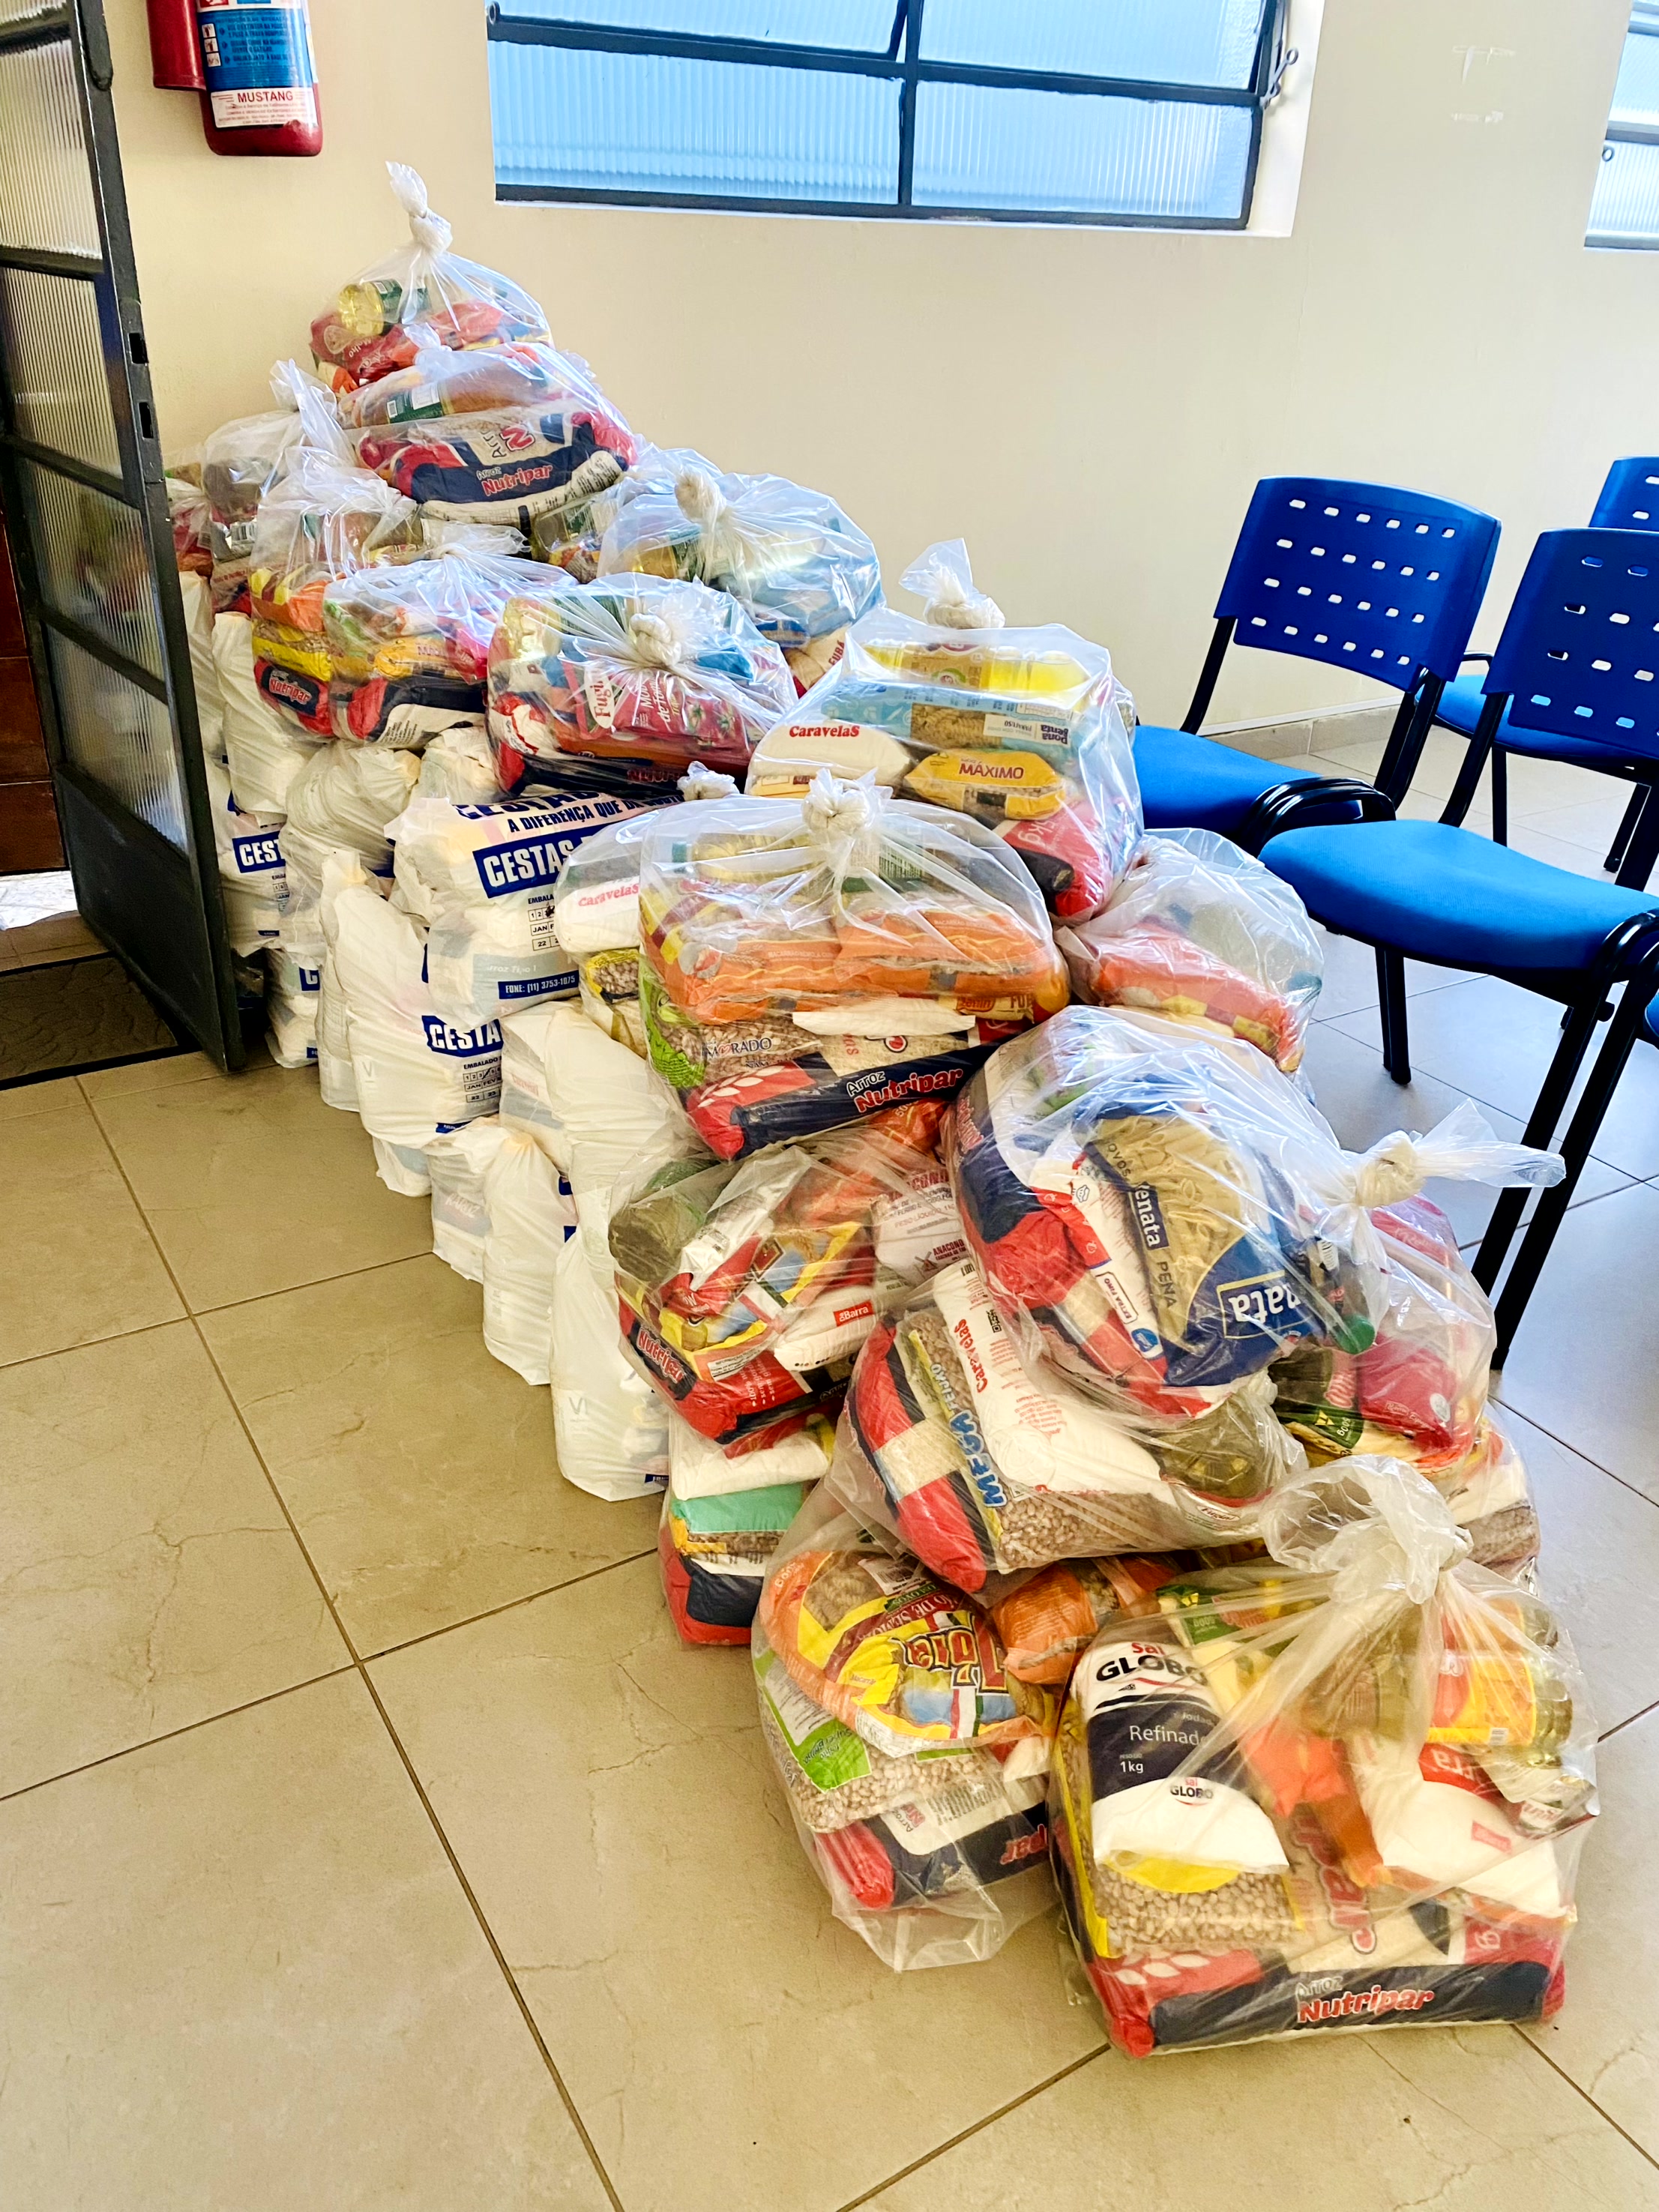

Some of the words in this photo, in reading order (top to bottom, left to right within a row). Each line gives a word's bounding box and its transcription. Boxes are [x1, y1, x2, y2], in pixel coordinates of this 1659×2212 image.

[237, 91, 293, 103] MUSTANG
[476, 466, 502, 480] Arroz
[481, 464, 553, 496] Nutripar
[269, 678, 313, 705] Nutripar
[1041, 724, 1069, 738] Benta
[1042, 732, 1068, 745] Dona
[959, 761, 1024, 780] MÁXIMO
[508, 819, 520, 834] A
[524, 804, 594, 831] DIFERENÇA
[596, 800, 623, 818] QUE
[239, 838, 284, 867] CEST
[528, 893, 555, 905] EMBALA
[532, 924, 548, 934] JAN
[505, 984, 526, 994] FONE:
[527, 983, 540, 994] (11)
[541, 975, 576, 990] 3753-1075
[1011, 994, 1033, 1009] FUB
[429, 1020, 502, 1050] CESTA
[463, 1057, 499, 1070] EMBALADO
[846, 1070, 886, 1097] Arroz
[853, 1068, 963, 1113] Nutripar
[932, 1238, 965, 1256] ANACOND
[1156, 1261, 1178, 1308] PENA
[1228, 1280, 1303, 1325] nata
[844, 1306, 869, 1320] Barra
[949, 1409, 1008, 1507] MEGA
[915, 1598, 936, 1618] DE
[1095, 1654, 1208, 1687] GLOBO
[1120, 1760, 1144, 1774] 1kg
[1169, 1785, 1214, 1800] GLOBO
[1297, 1985, 1436, 2024] Nutripar
